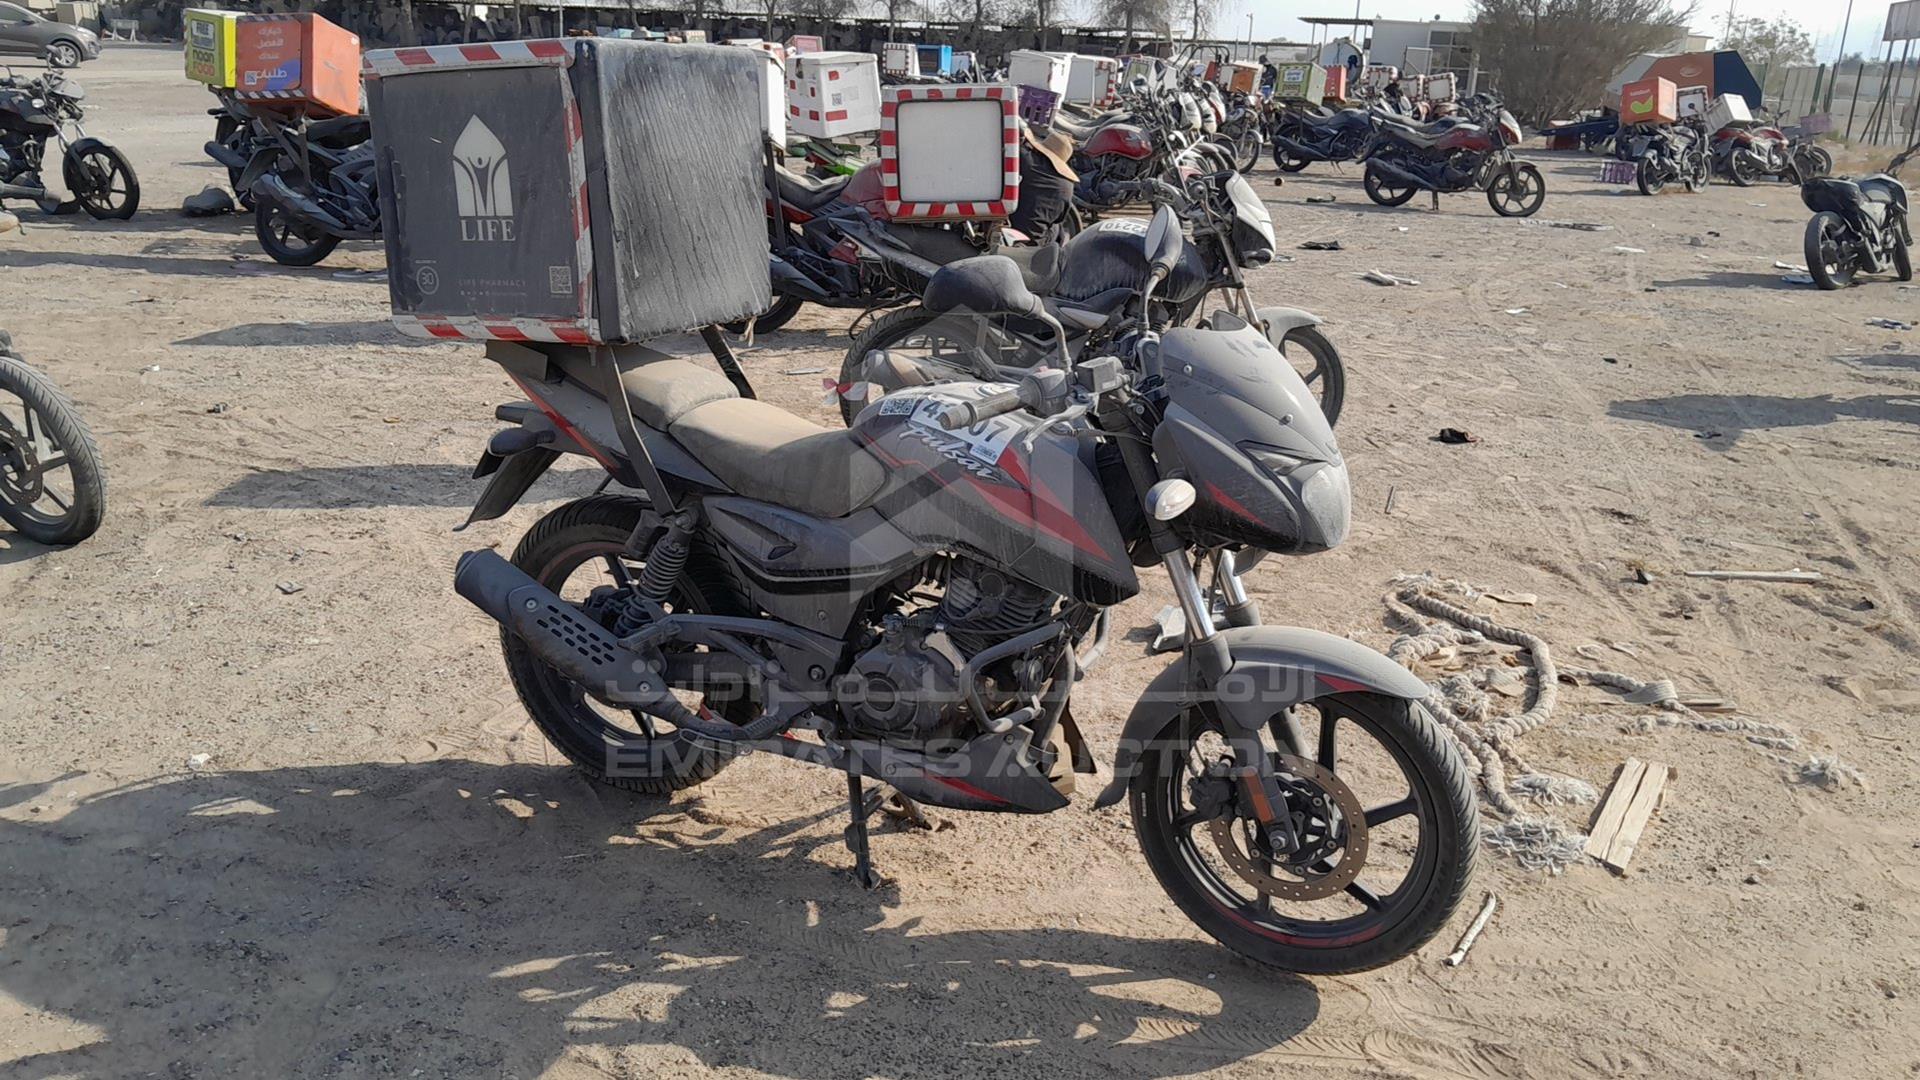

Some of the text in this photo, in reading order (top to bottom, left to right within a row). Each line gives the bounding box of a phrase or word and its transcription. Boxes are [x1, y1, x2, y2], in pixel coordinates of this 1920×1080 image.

[193, 49, 215, 65] noon
[460, 219, 516, 242] LIFE
[421, 271, 434, 286] 30
[459, 278, 527, 288] LIFE PHARMACY
